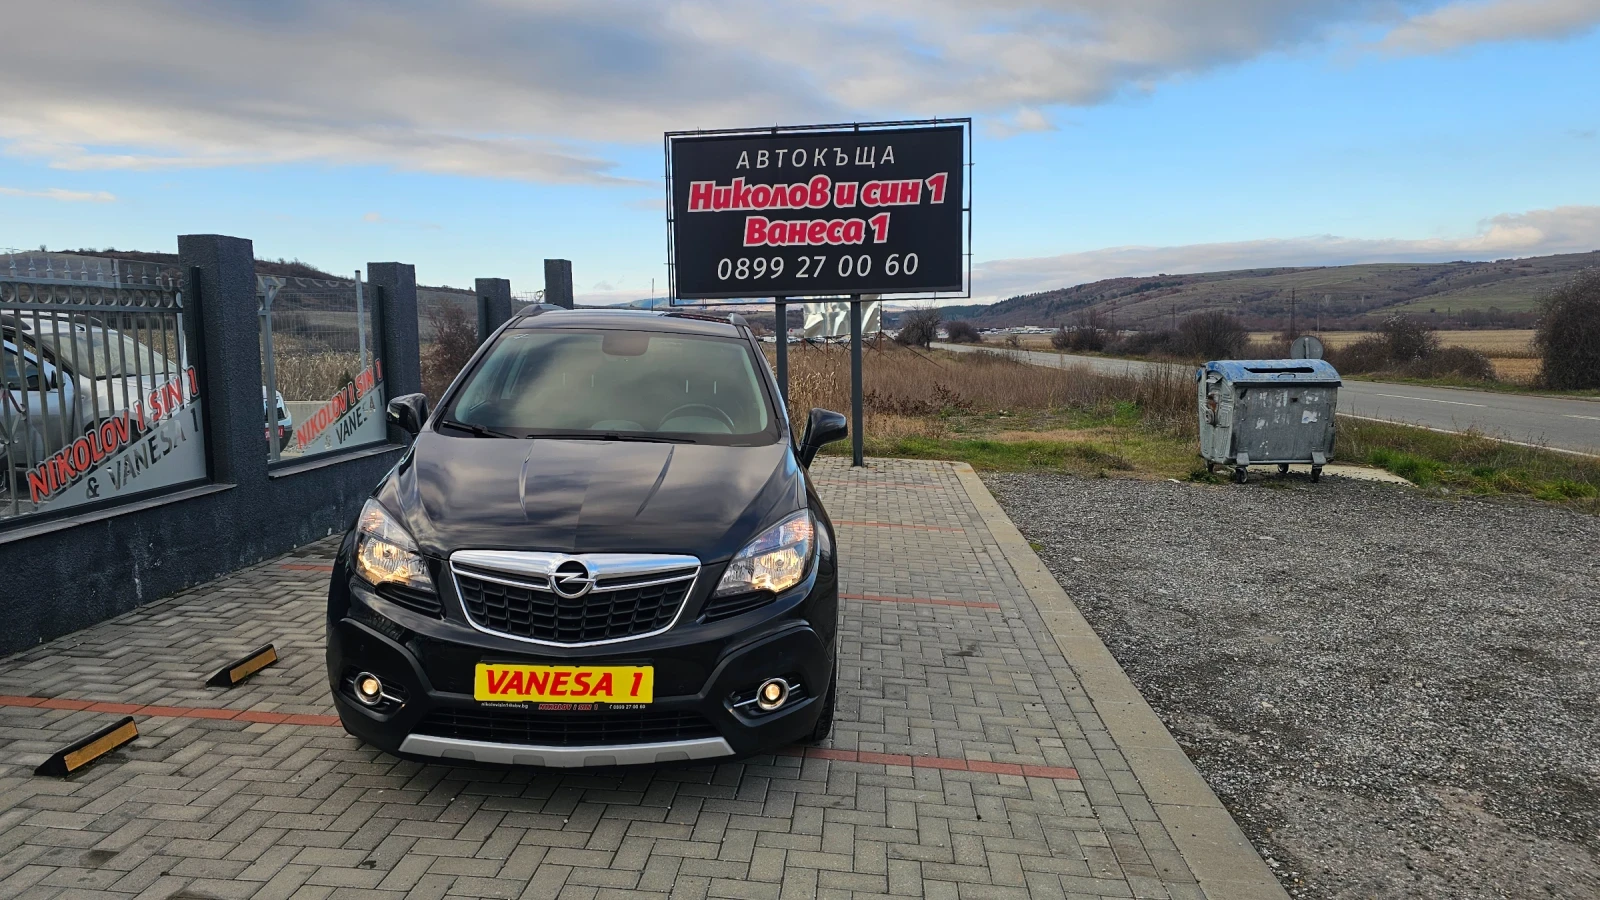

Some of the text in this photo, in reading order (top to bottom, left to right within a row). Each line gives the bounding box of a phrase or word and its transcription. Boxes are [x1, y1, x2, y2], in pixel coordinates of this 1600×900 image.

[736, 146, 895, 169] АВТОКЪЩА
[687, 172, 948, 212] Николов и син 1
[743, 212, 891, 246] Ванеса 1
[717, 252, 919, 280] 0899 27 00 60
[296, 386, 348, 450] NIKOLOV
[355, 365, 374, 400] SIN
[375, 357, 383, 381] 1
[26, 408, 131, 505] NIKOLOV
[148, 376, 184, 423] SIN
[186, 366, 200, 398] 1
[86, 407, 199, 499] & VANESA 1
[486, 669, 643, 696] VANESA 1
[538, 703, 572, 711] NIKOLOV
